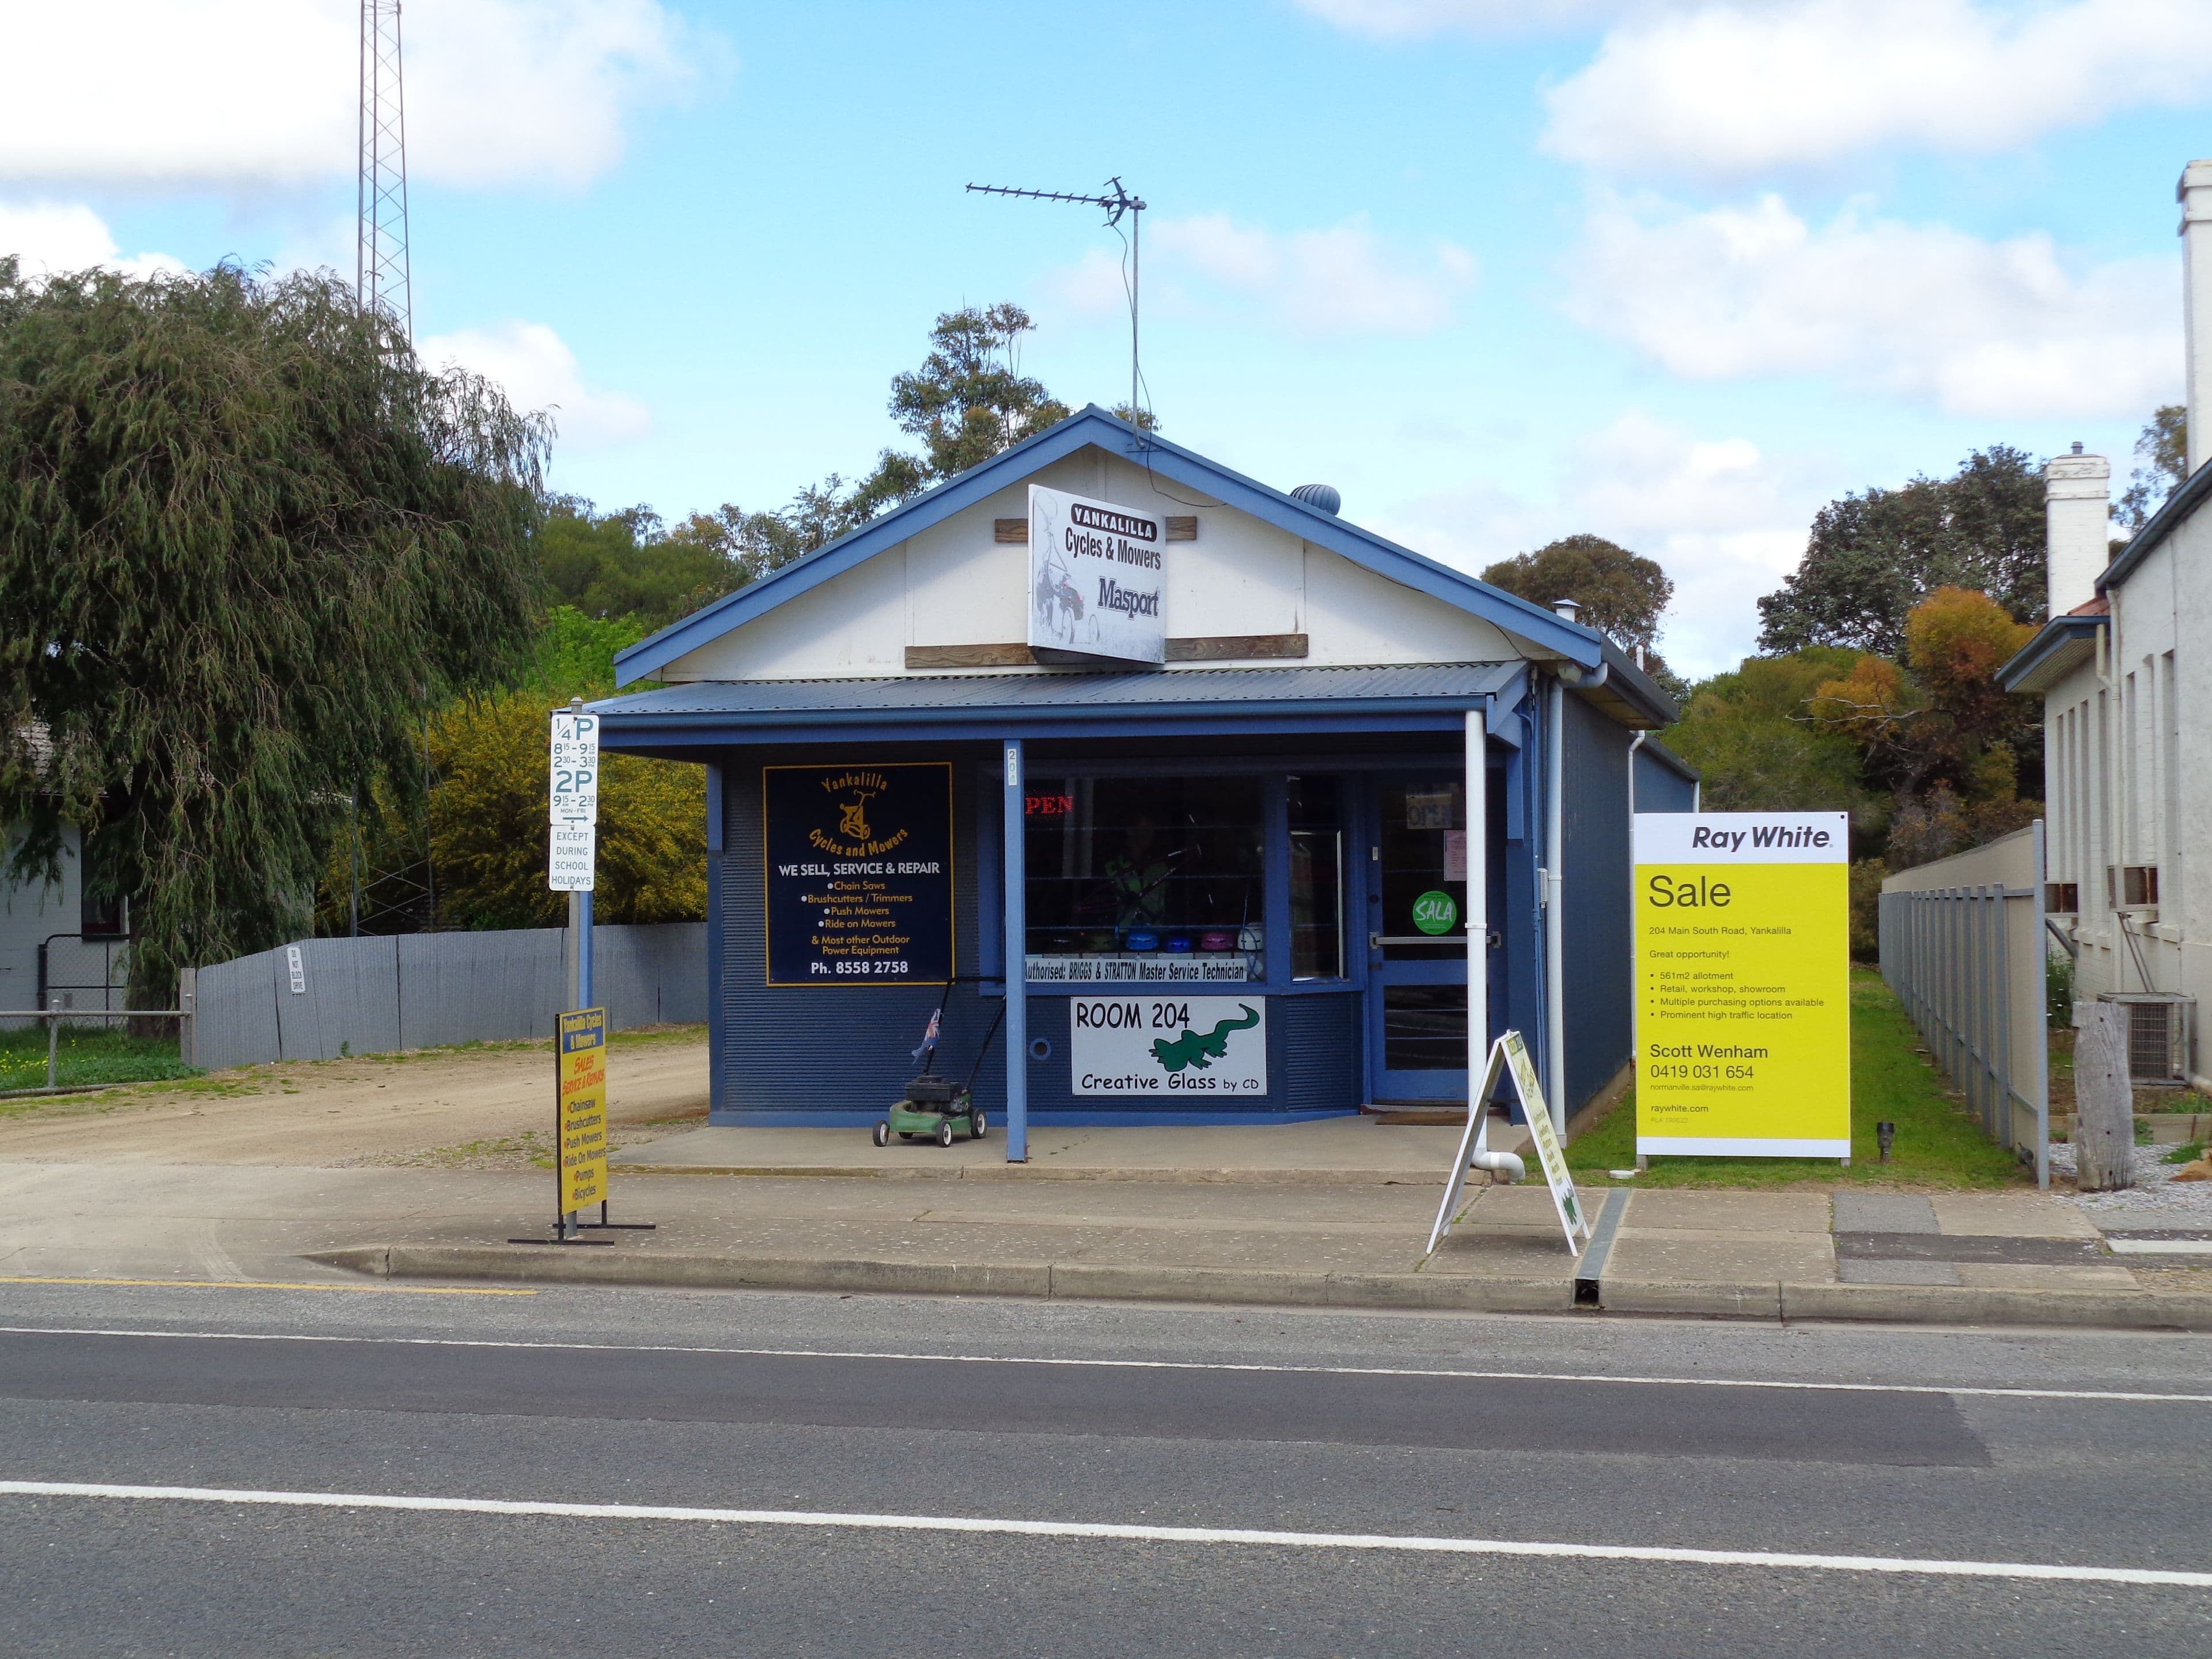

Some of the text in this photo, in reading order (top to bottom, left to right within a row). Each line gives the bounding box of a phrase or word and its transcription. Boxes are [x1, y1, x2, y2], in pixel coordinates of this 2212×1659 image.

[1074, 507, 1153, 539] YANKALILLA
[1066, 527, 1161, 570] Cycles & Mowers
[1098, 576, 1159, 620] Masport
[576, 718, 593, 740] P
[821, 772, 888, 793] Yankalilla
[1025, 796, 1074, 813] PEN
[556, 832, 589, 841] EXCEPT
[809, 828, 908, 857] Cycles and Mowers
[1692, 826, 1830, 853] Ray White
[556, 847, 588, 856] DURING
[555, 861, 588, 870] SCHOOL
[779, 862, 940, 877] WE SELL, SERVICE & REPAIR
[551, 876, 591, 885] HOLIDAYS
[834, 881, 885, 890] Chain Saws
[808, 894, 863, 903] Brushcutters
[871, 893, 912, 902] Trimmers
[1649, 875, 1731, 907] Sale
[831, 907, 889, 915] Push Mowers
[1415, 900, 1452, 922] SALA
[825, 919, 844, 928] Ride
[861, 919, 896, 927] Mowers
[1649, 926, 1791, 936] 204 Main South Road, Yankalilla
[811, 935, 910, 945] & Most other Outdoor
[823, 946, 899, 957] Power Equipment
[1649, 949, 1729, 961] Great opportunity!
[811, 961, 908, 974] Ph. 8558 2758
[1069, 961, 1092, 980] BRIGGS
[1096, 962, 1101, 979] &
[1104, 961, 1137, 980] STRATTON
[1139, 962, 1166, 980] Master
[1169, 962, 1199, 980] Service
[1202, 962, 1244, 980] Technician
[1660, 971, 1734, 980] 561m2 allotment
[1660, 984, 1786, 995] Retail, workshop, showroom
[1660, 997, 1824, 1009] Multiple purchasing options available
[1076, 1002, 1190, 1029] ROOM 204
[1660, 1011, 1793, 1021] Prominent high traffic location
[1650, 1044, 1768, 1059] Scott Wenham
[1650, 1065, 1754, 1079] 0419 031 654
[1081, 1073, 1259, 1092] Creative Glass by CD
[570, 1099, 596, 1113] Chainsaw
[1651, 1104, 1709, 1113] raywhite.com
[567, 1113, 601, 1132] Brushcutters
[567, 1131, 602, 1150] Push Mowers
[565, 1147, 606, 1168] Ride On Mowers
[576, 1168, 594, 1183] Pumps
[574, 1184, 596, 1201] Bicycles
